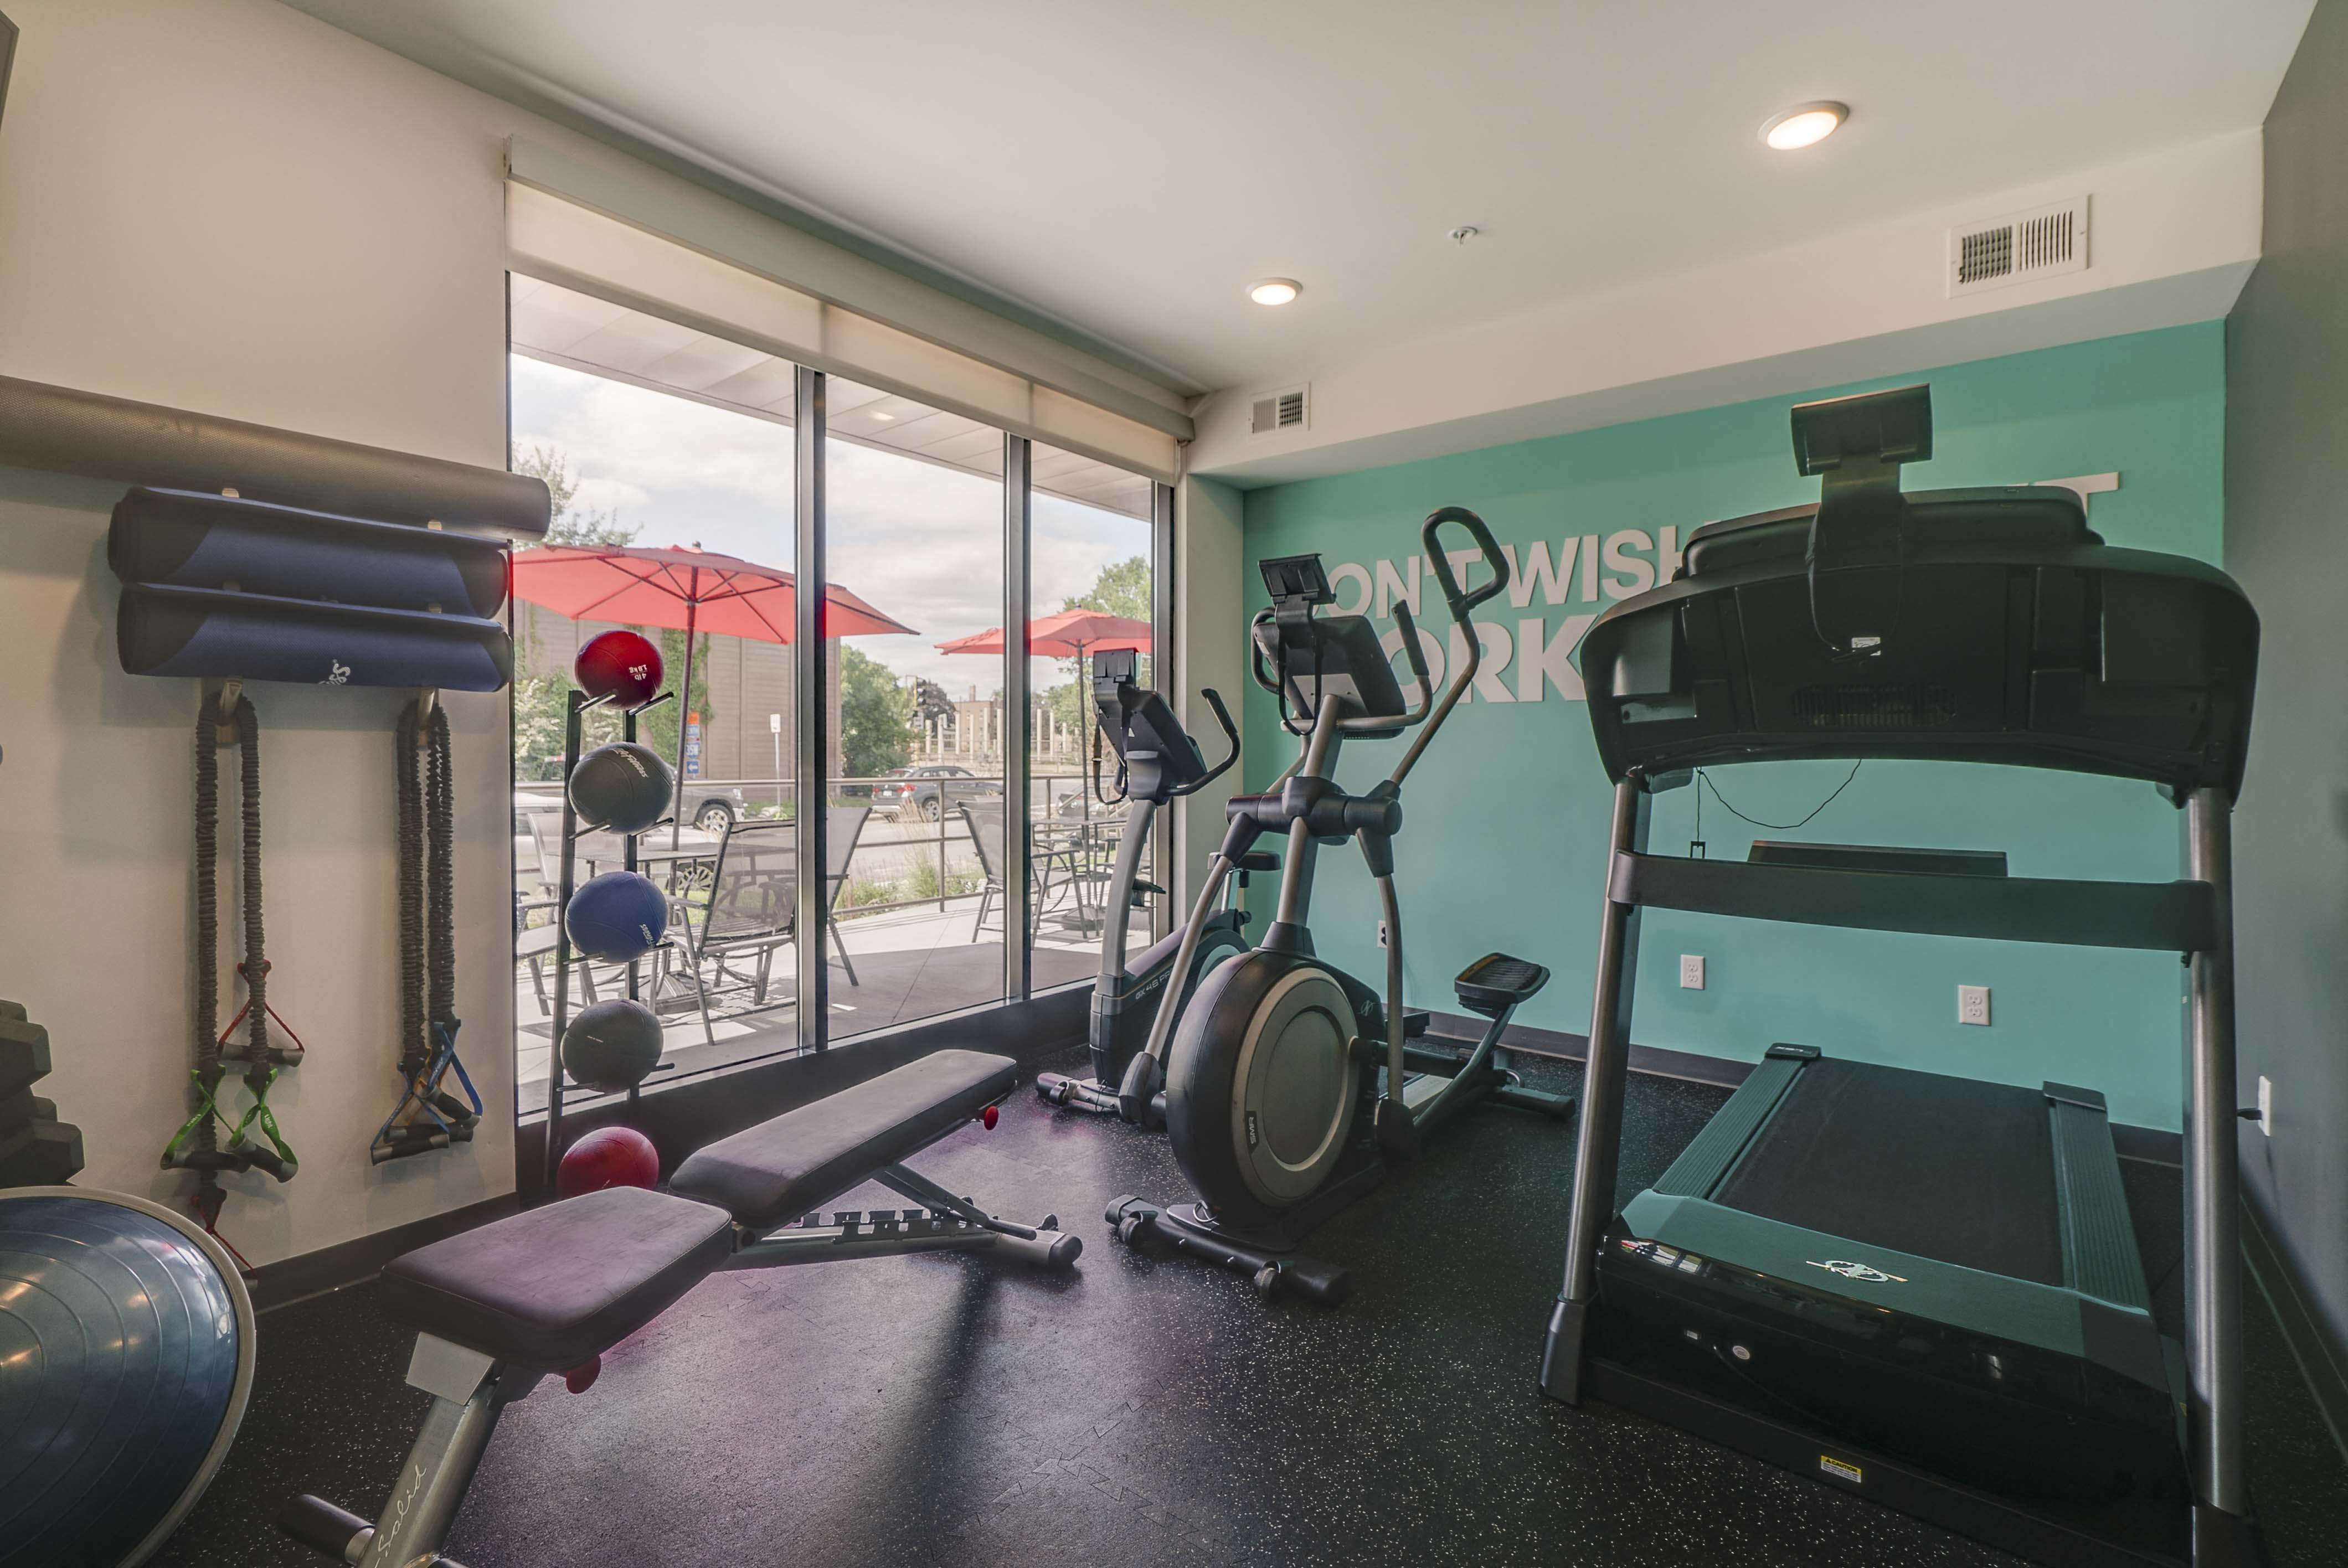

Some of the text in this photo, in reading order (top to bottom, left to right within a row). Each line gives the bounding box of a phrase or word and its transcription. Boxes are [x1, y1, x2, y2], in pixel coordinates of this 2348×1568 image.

[1313, 549, 1484, 620] ON'T
[1378, 614, 1600, 708] ORK
[1160, 970, 1171, 983] PR
[1831, 1460, 1857, 1473] CAUTION
